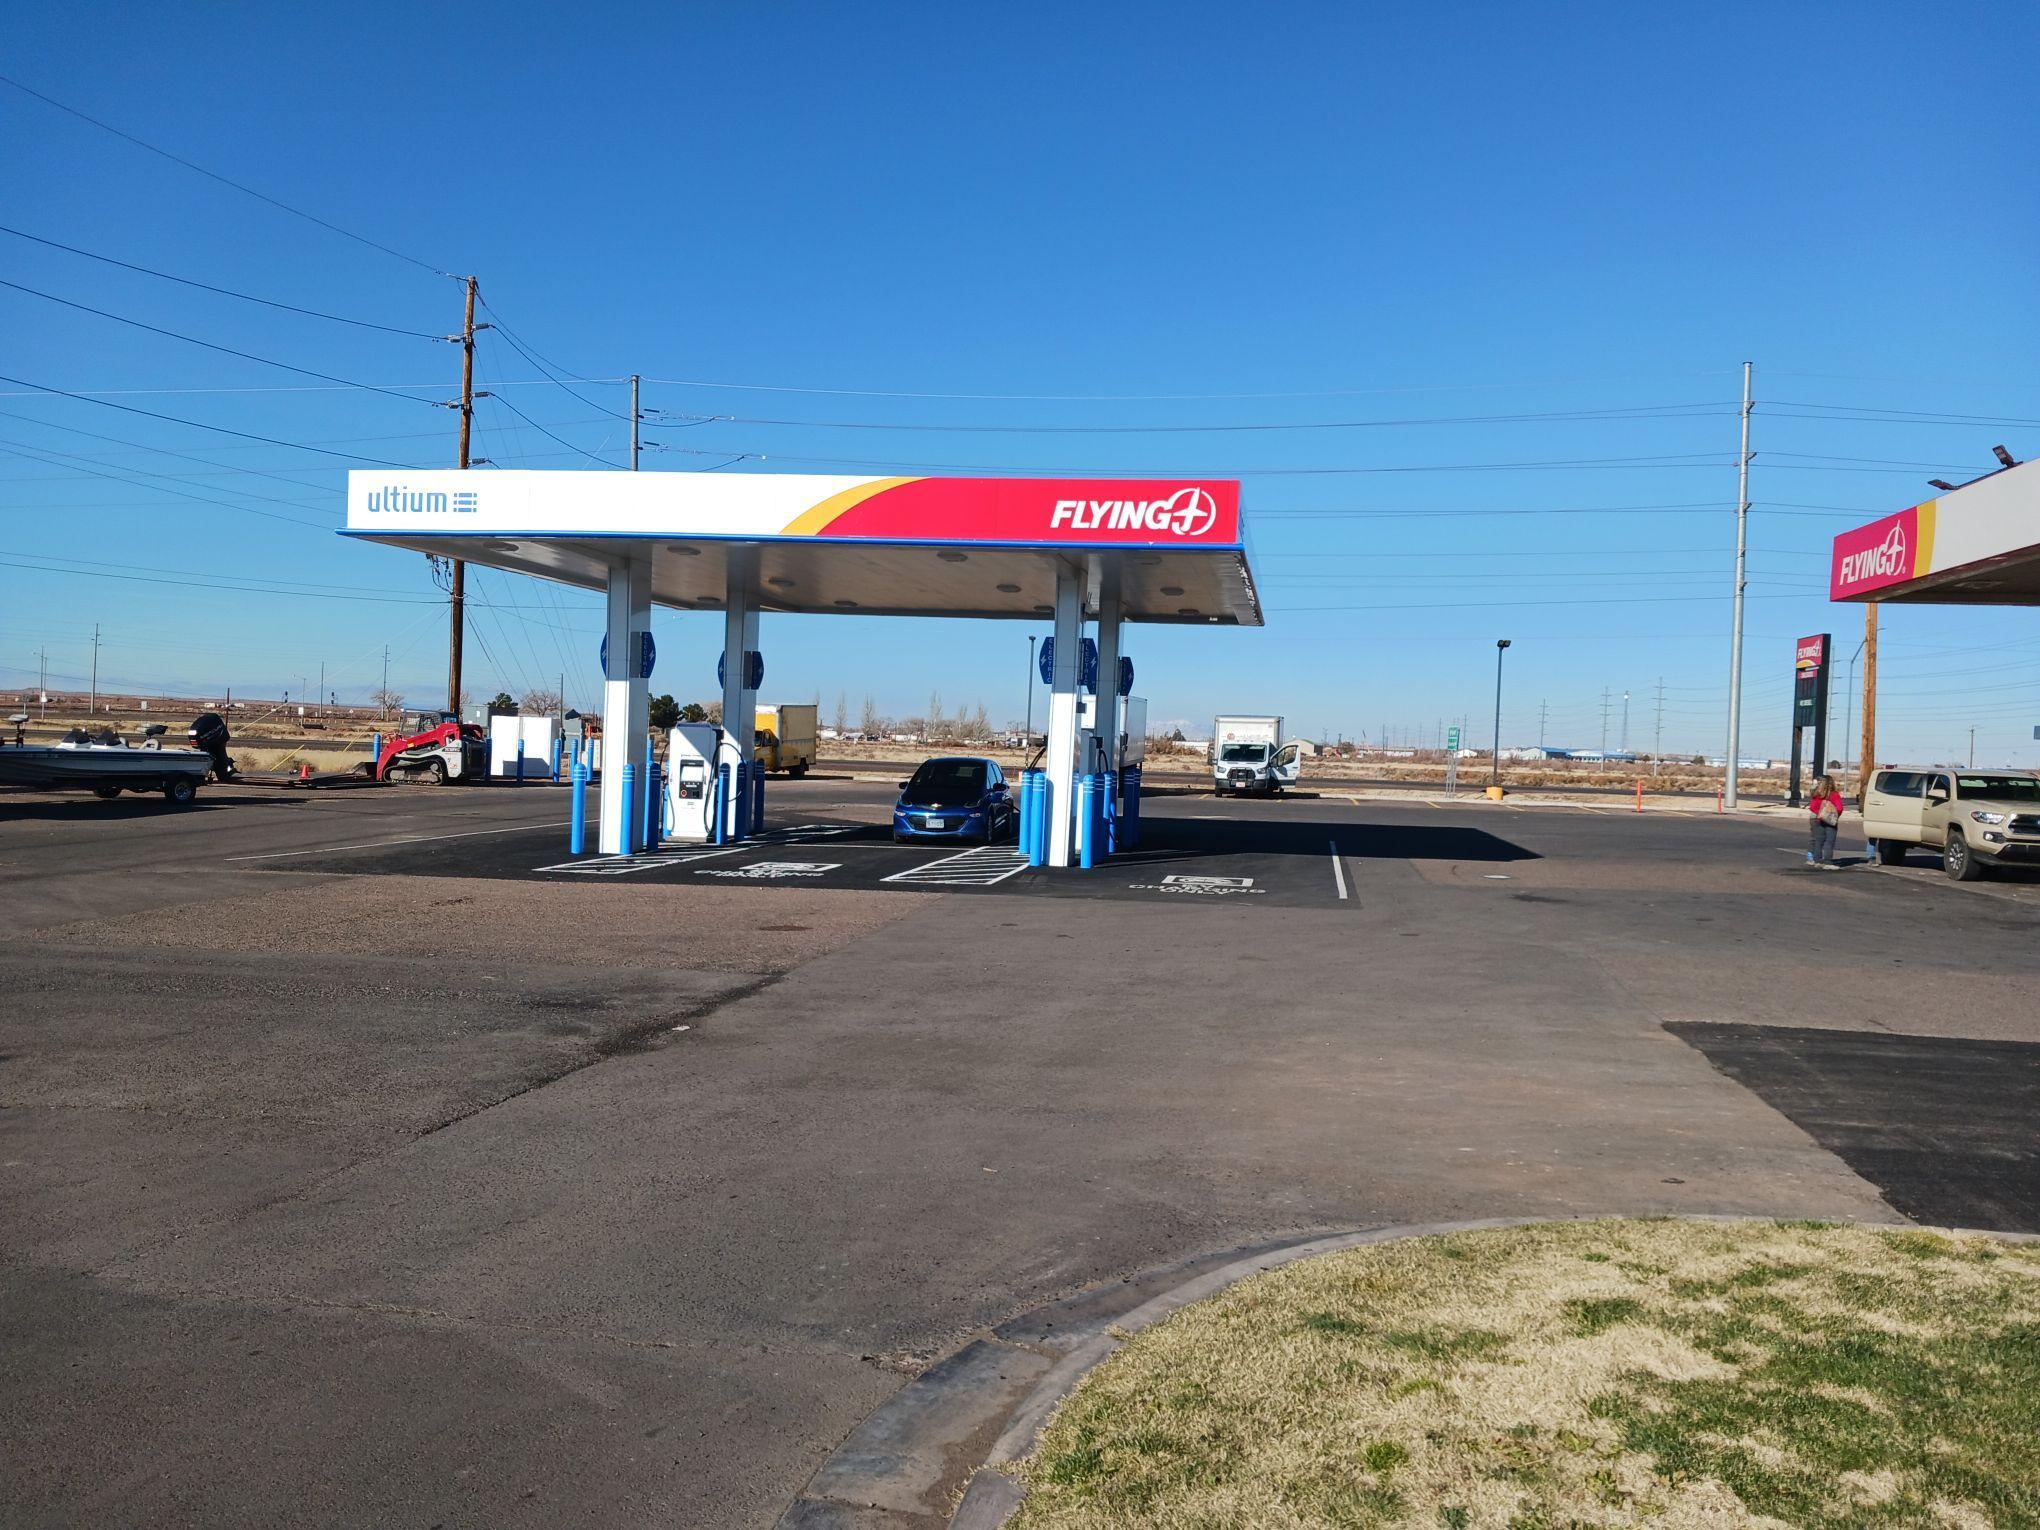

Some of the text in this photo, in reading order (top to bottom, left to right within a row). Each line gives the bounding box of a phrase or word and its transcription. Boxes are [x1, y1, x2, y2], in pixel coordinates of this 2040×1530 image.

[367, 485, 448, 513] ultium
[1050, 500, 1173, 530] FLYING
[1839, 543, 1888, 586] FLYING
